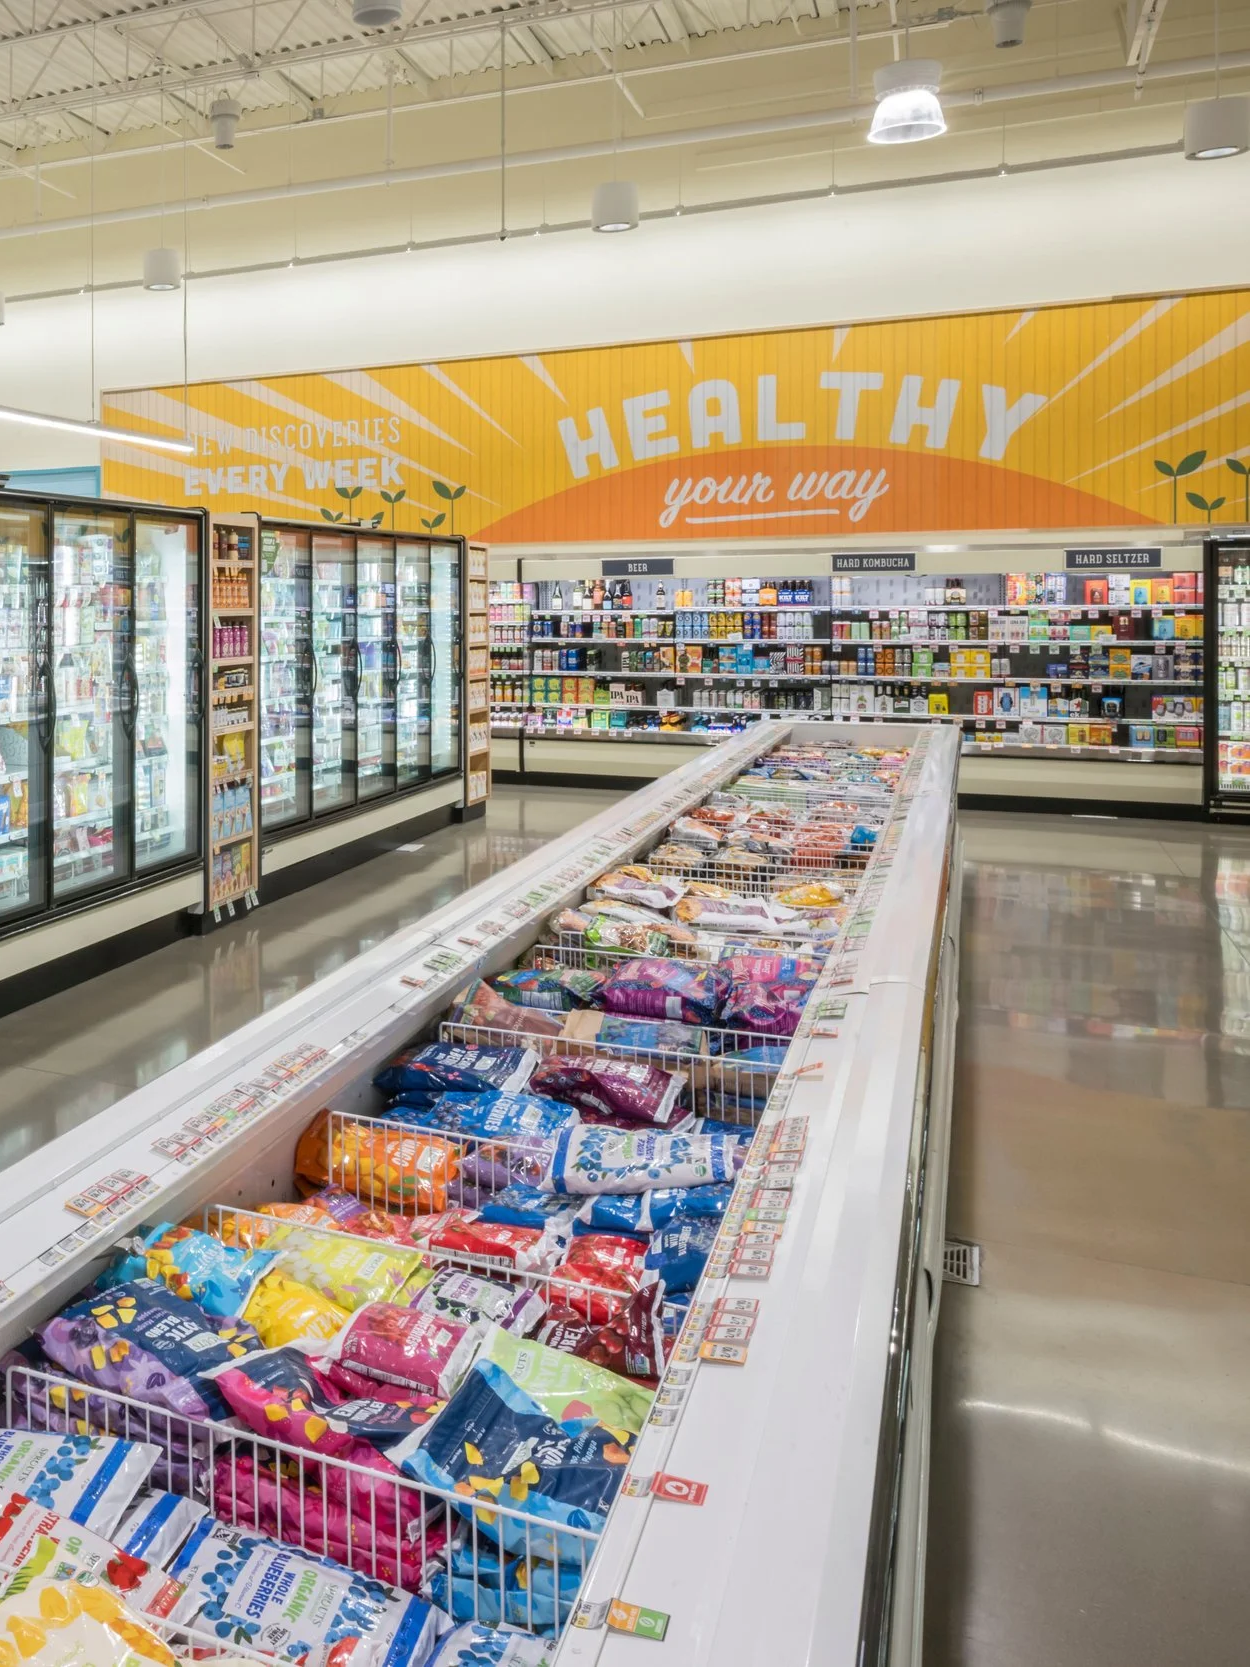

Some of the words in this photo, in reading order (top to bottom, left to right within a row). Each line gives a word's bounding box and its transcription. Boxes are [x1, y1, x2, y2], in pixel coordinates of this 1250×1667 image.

[187, 431, 234, 457] NEW
[246, 417, 400, 453] DISCOVERIES
[557, 372, 1048, 479] HEALTHY
[184, 463, 289, 496] EVERY
[302, 456, 404, 490] WEEK
[658, 472, 775, 527] your
[787, 468, 890, 522] way
[628, 563, 648, 573] BEER
[837, 558, 860, 569] HARD
[863, 557, 910, 568] KOMBUCHA
[1075, 554, 1103, 564] HARD
[1106, 553, 1150, 564] SELTZER
[246, 1552, 292, 1620] BLUEBERRIES
[273, 1573, 296, 1605] WHOLE
[282, 1569, 318, 1624] ORGANIC
[312, 1583, 338, 1628] SPROUTS
